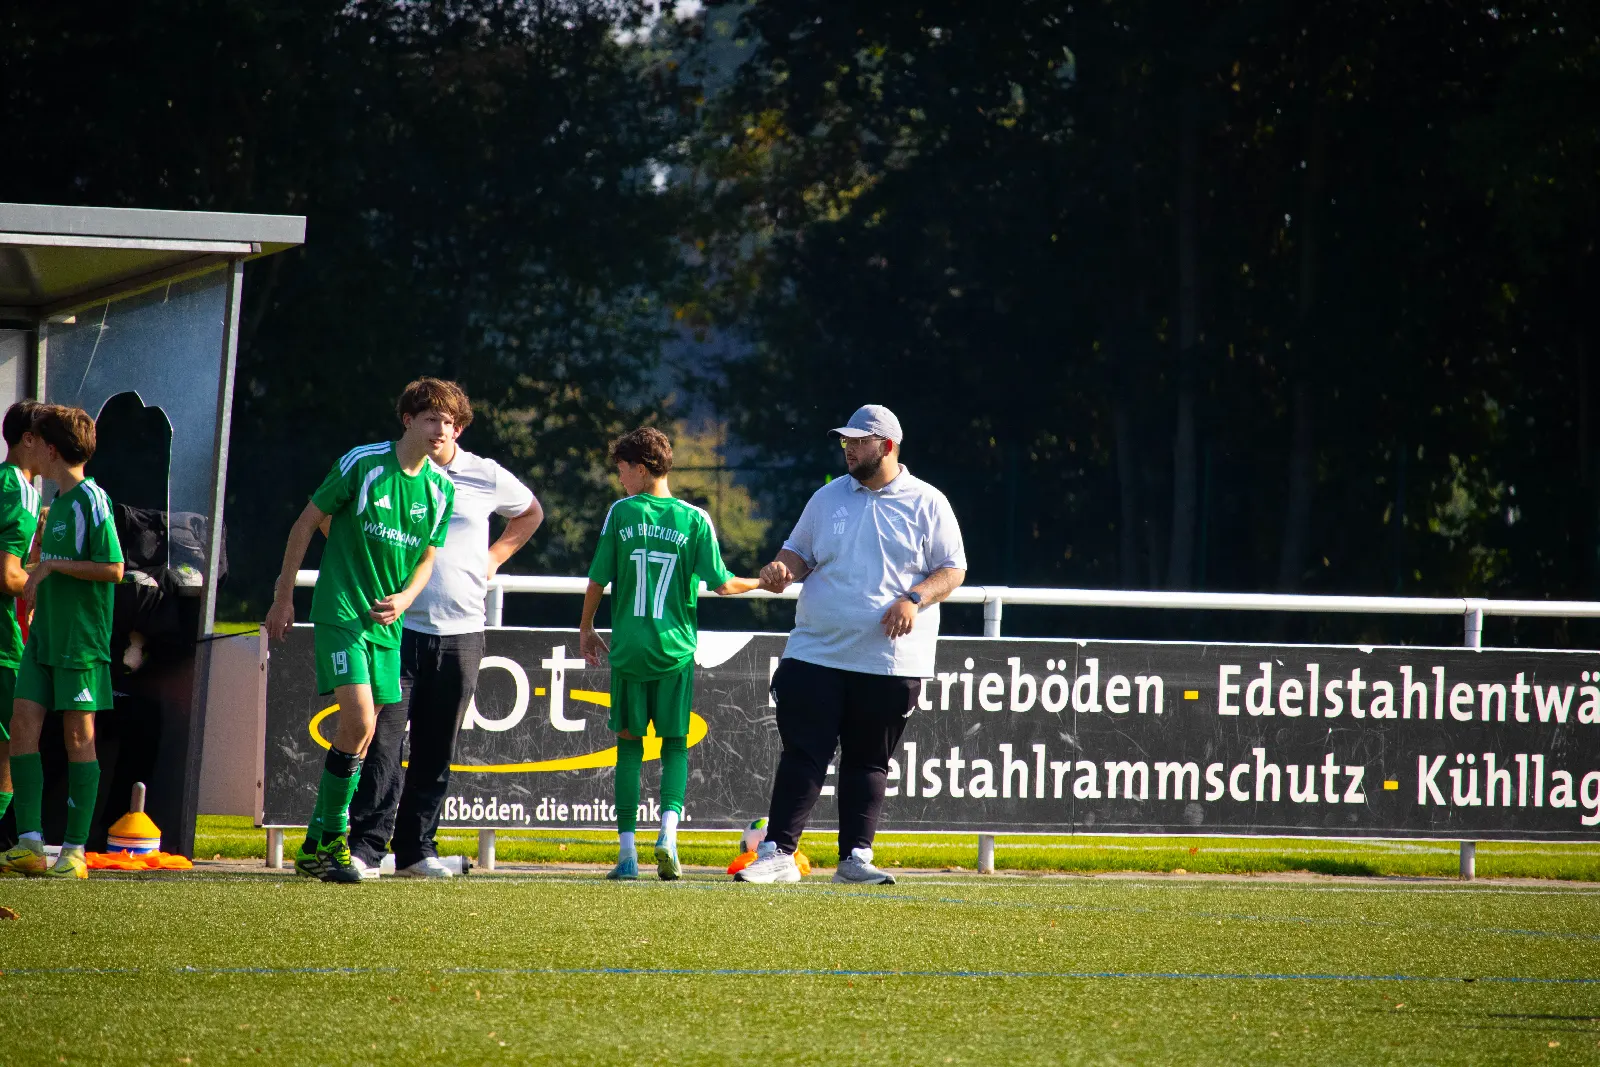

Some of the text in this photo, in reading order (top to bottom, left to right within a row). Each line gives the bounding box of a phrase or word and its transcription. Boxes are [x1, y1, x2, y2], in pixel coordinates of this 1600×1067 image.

[364, 520, 421, 548] WÖHRMANN
[619, 526, 634, 541] GW
[629, 548, 678, 620] 17
[330, 650, 348, 675] 19
[439, 796, 531, 826] ßböden,
[535, 797, 569, 822] die
